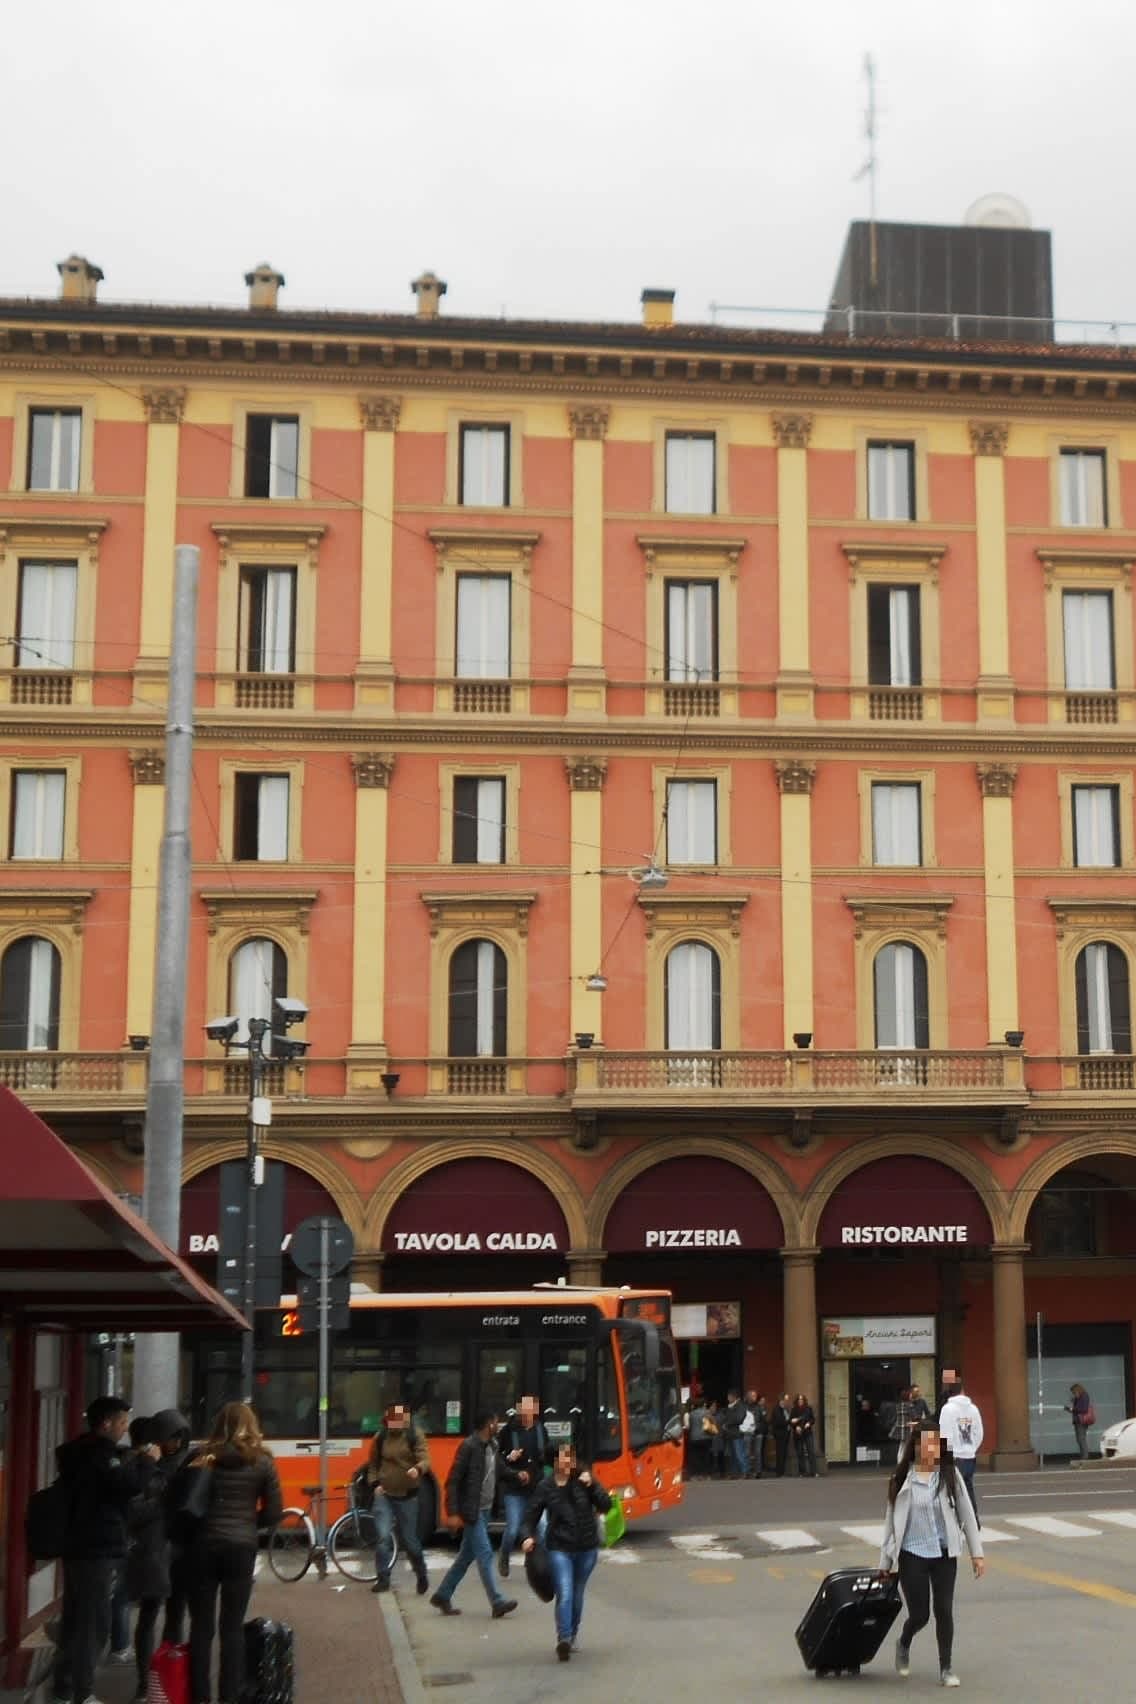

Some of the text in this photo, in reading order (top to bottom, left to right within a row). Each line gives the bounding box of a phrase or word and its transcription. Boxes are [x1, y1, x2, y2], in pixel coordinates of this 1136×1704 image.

[394, 1232, 558, 1250] TAVOLA CALDA
[645, 1229, 742, 1247] PIZZERIA
[841, 1226, 968, 1243] RISTORANTE
[482, 1313, 587, 1326] entrata entrance
